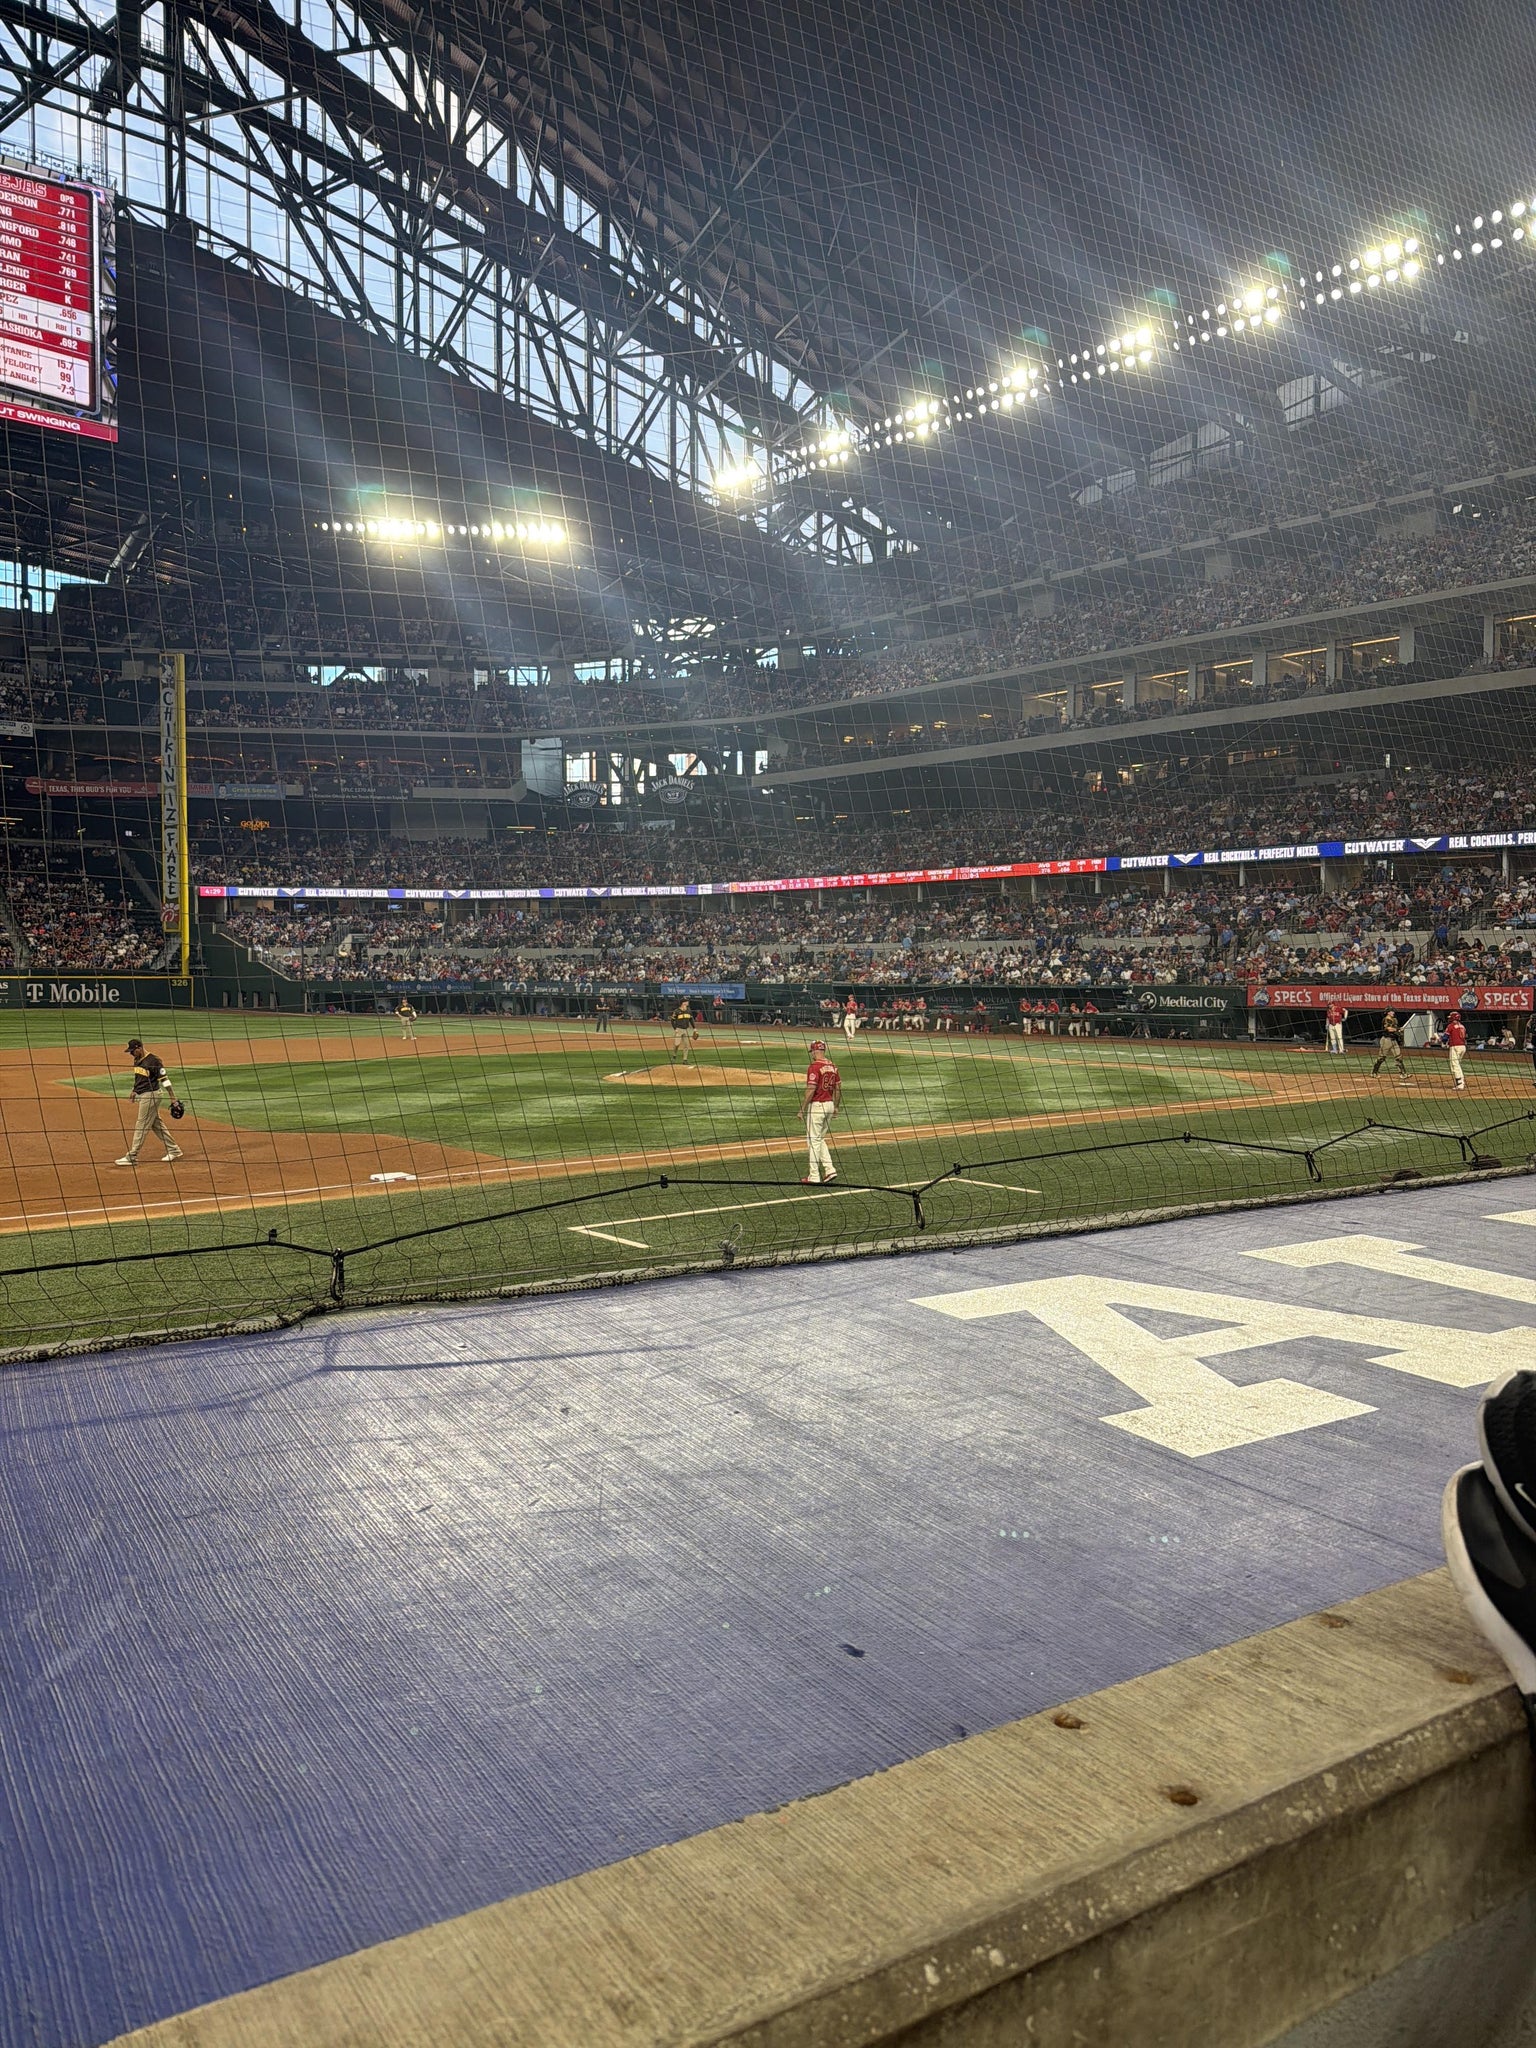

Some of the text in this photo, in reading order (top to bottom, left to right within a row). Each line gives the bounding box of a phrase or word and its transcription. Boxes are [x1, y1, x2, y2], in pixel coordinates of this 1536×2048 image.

[60, 194, 75, 205] OPS
[58, 207, 75, 219] .771
[58, 251, 76, 263] .741
[58, 266, 77, 278] .769
[65, 280, 71, 290] K
[65, 295, 72, 305] K
[55, 323, 67, 332] RBI
[76, 327, 81, 336] 5
[60, 337, 78, 350] .692
[3, 356, 71, 382] VELOCITY 99
[57, 359, 74, 371] 15.7
[10, 369, 38, 384] ANGLE
[57, 384, 75, 395] -7.3
[17, 410, 81, 430] SWINGING
[651, 779, 668, 792] JACK
[162, 691, 177, 895] CHIKIN IZ FARE
[1345, 839, 1405, 854] CUTWATER
[1449, 835, 1468, 849] REAL
[1470, 833, 1515, 847] COCKTAILS.
[1203, 850, 1220, 863] REAL
[1221, 849, 1257, 862] COCKTAILS.
[1259, 847, 1295, 860] PERFECTLY
[1120, 855, 1169, 868] CUTWATER
[990, 865, 1012, 873] LOPEZ
[239, 888, 278, 897] CUTWATER
[405, 889, 444, 898] CUTWATER
[554, 888, 588, 897] CUTWATER
[171, 979, 188, 987] 326
[533, 985, 559, 993] American
[26, 983, 120, 1003] T Mobile
[599, 986, 627, 994] American
[1274, 989, 1312, 1003] SPEC'S
[1159, 995, 1228, 1011] Medical City
[1319, 992, 1450, 1004] Official Liquor Store of the Texas Rangers
[1484, 990, 1528, 1006] SPEC'S
